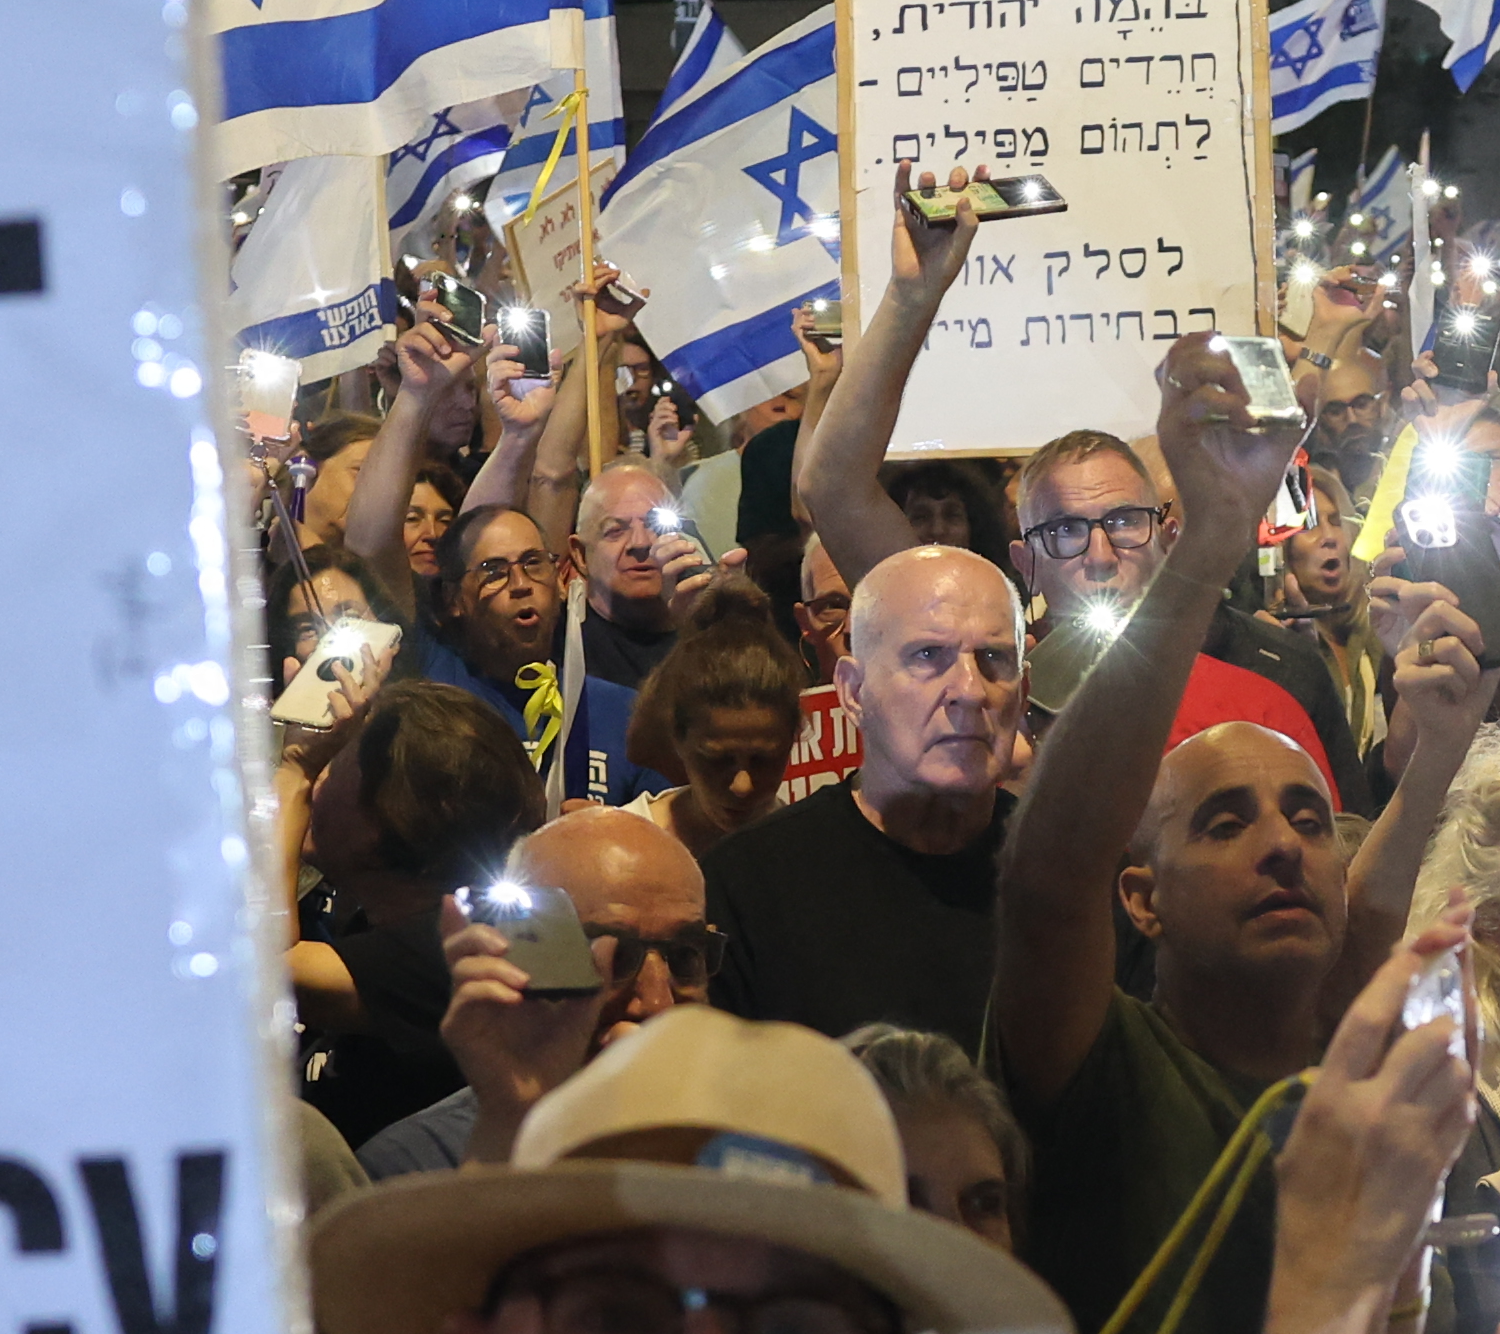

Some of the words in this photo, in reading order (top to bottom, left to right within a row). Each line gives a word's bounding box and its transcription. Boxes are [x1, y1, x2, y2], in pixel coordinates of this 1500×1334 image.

[1043, 237, 1183, 296] לסלק
[317, 288, 378, 327] חופשי
[321, 307, 382, 347] בארצנו
